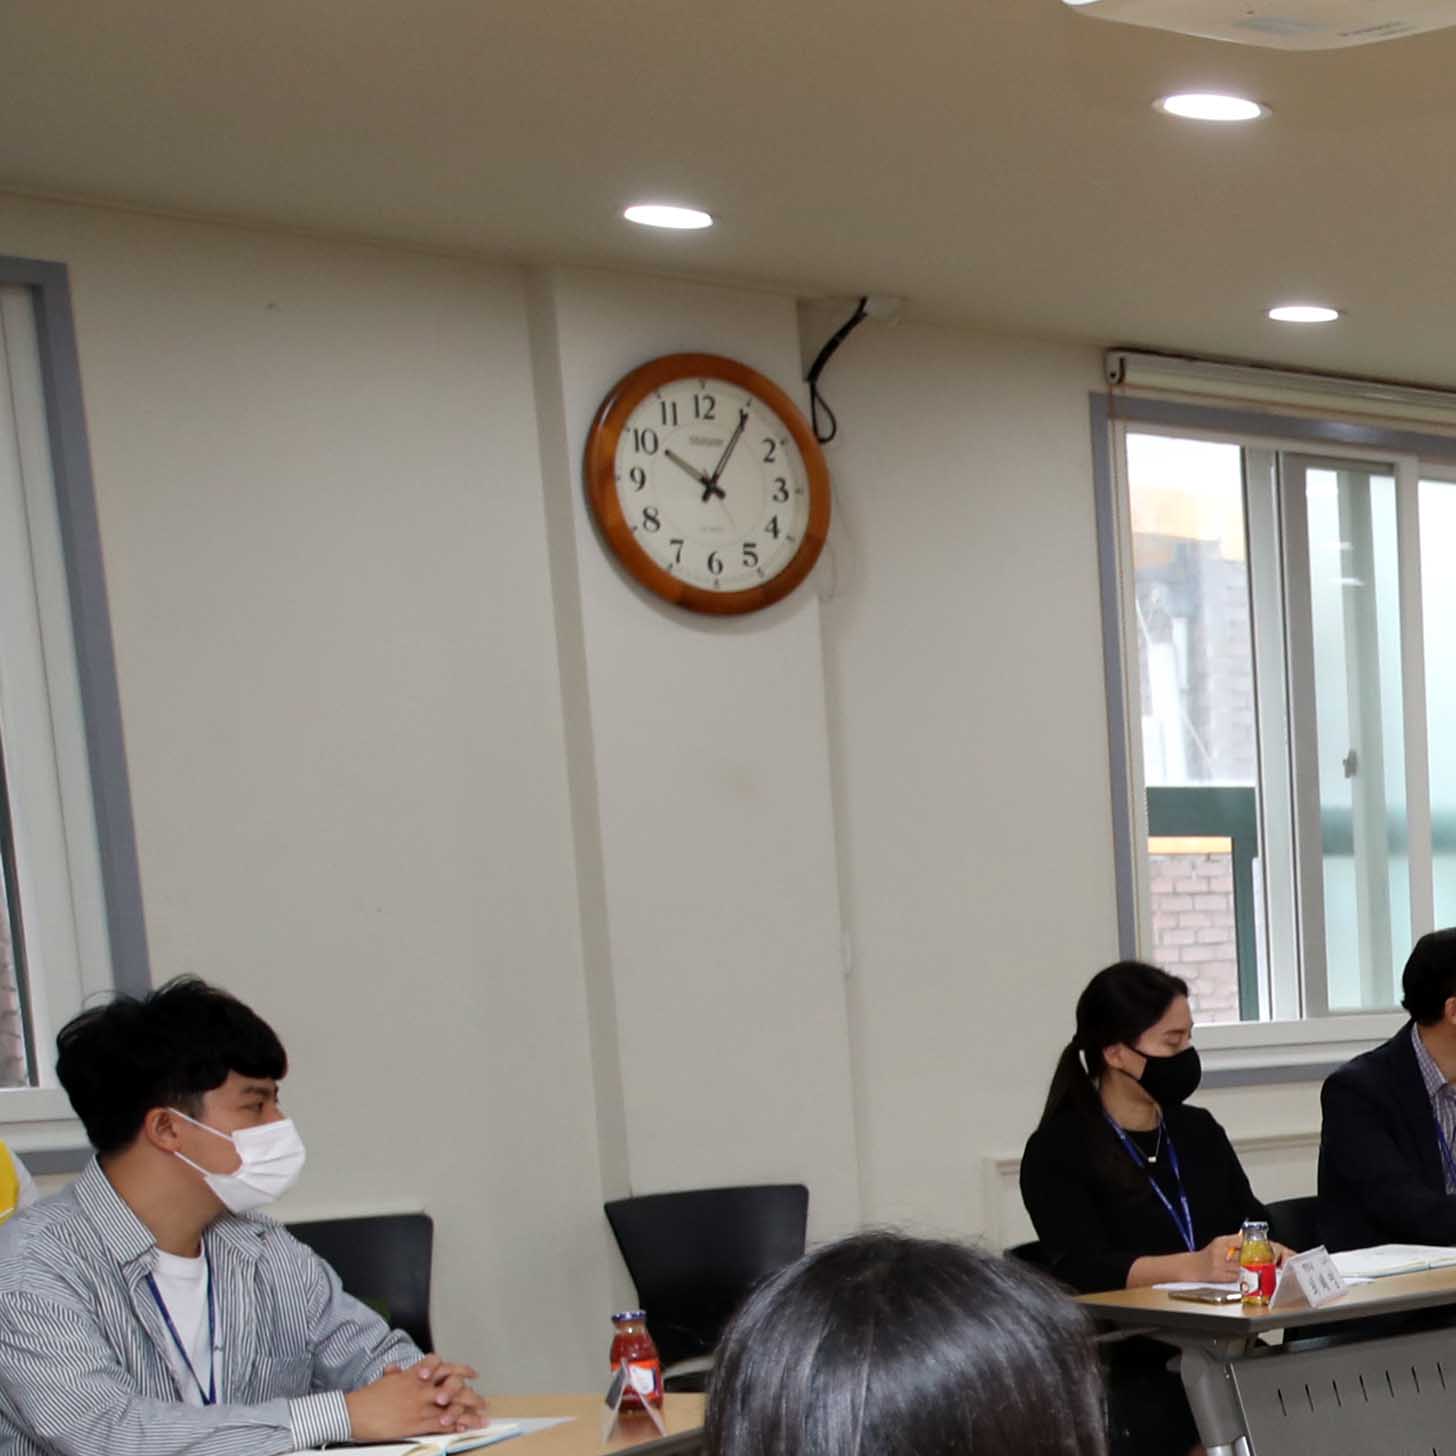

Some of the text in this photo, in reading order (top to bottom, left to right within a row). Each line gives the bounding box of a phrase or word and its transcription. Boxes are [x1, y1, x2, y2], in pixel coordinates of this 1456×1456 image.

[660, 400, 678, 427] 11
[693, 394, 716, 420] 12
[633, 428, 659, 455] 10
[762, 438, 776, 463] 2
[629, 467, 646, 492] 9
[772, 477, 789, 502] 3
[642, 506, 661, 532] 8
[764, 515, 780, 539] 4
[670, 540, 684, 564] 7
[707, 552, 723, 575] 6
[742, 542, 759, 567] 5
